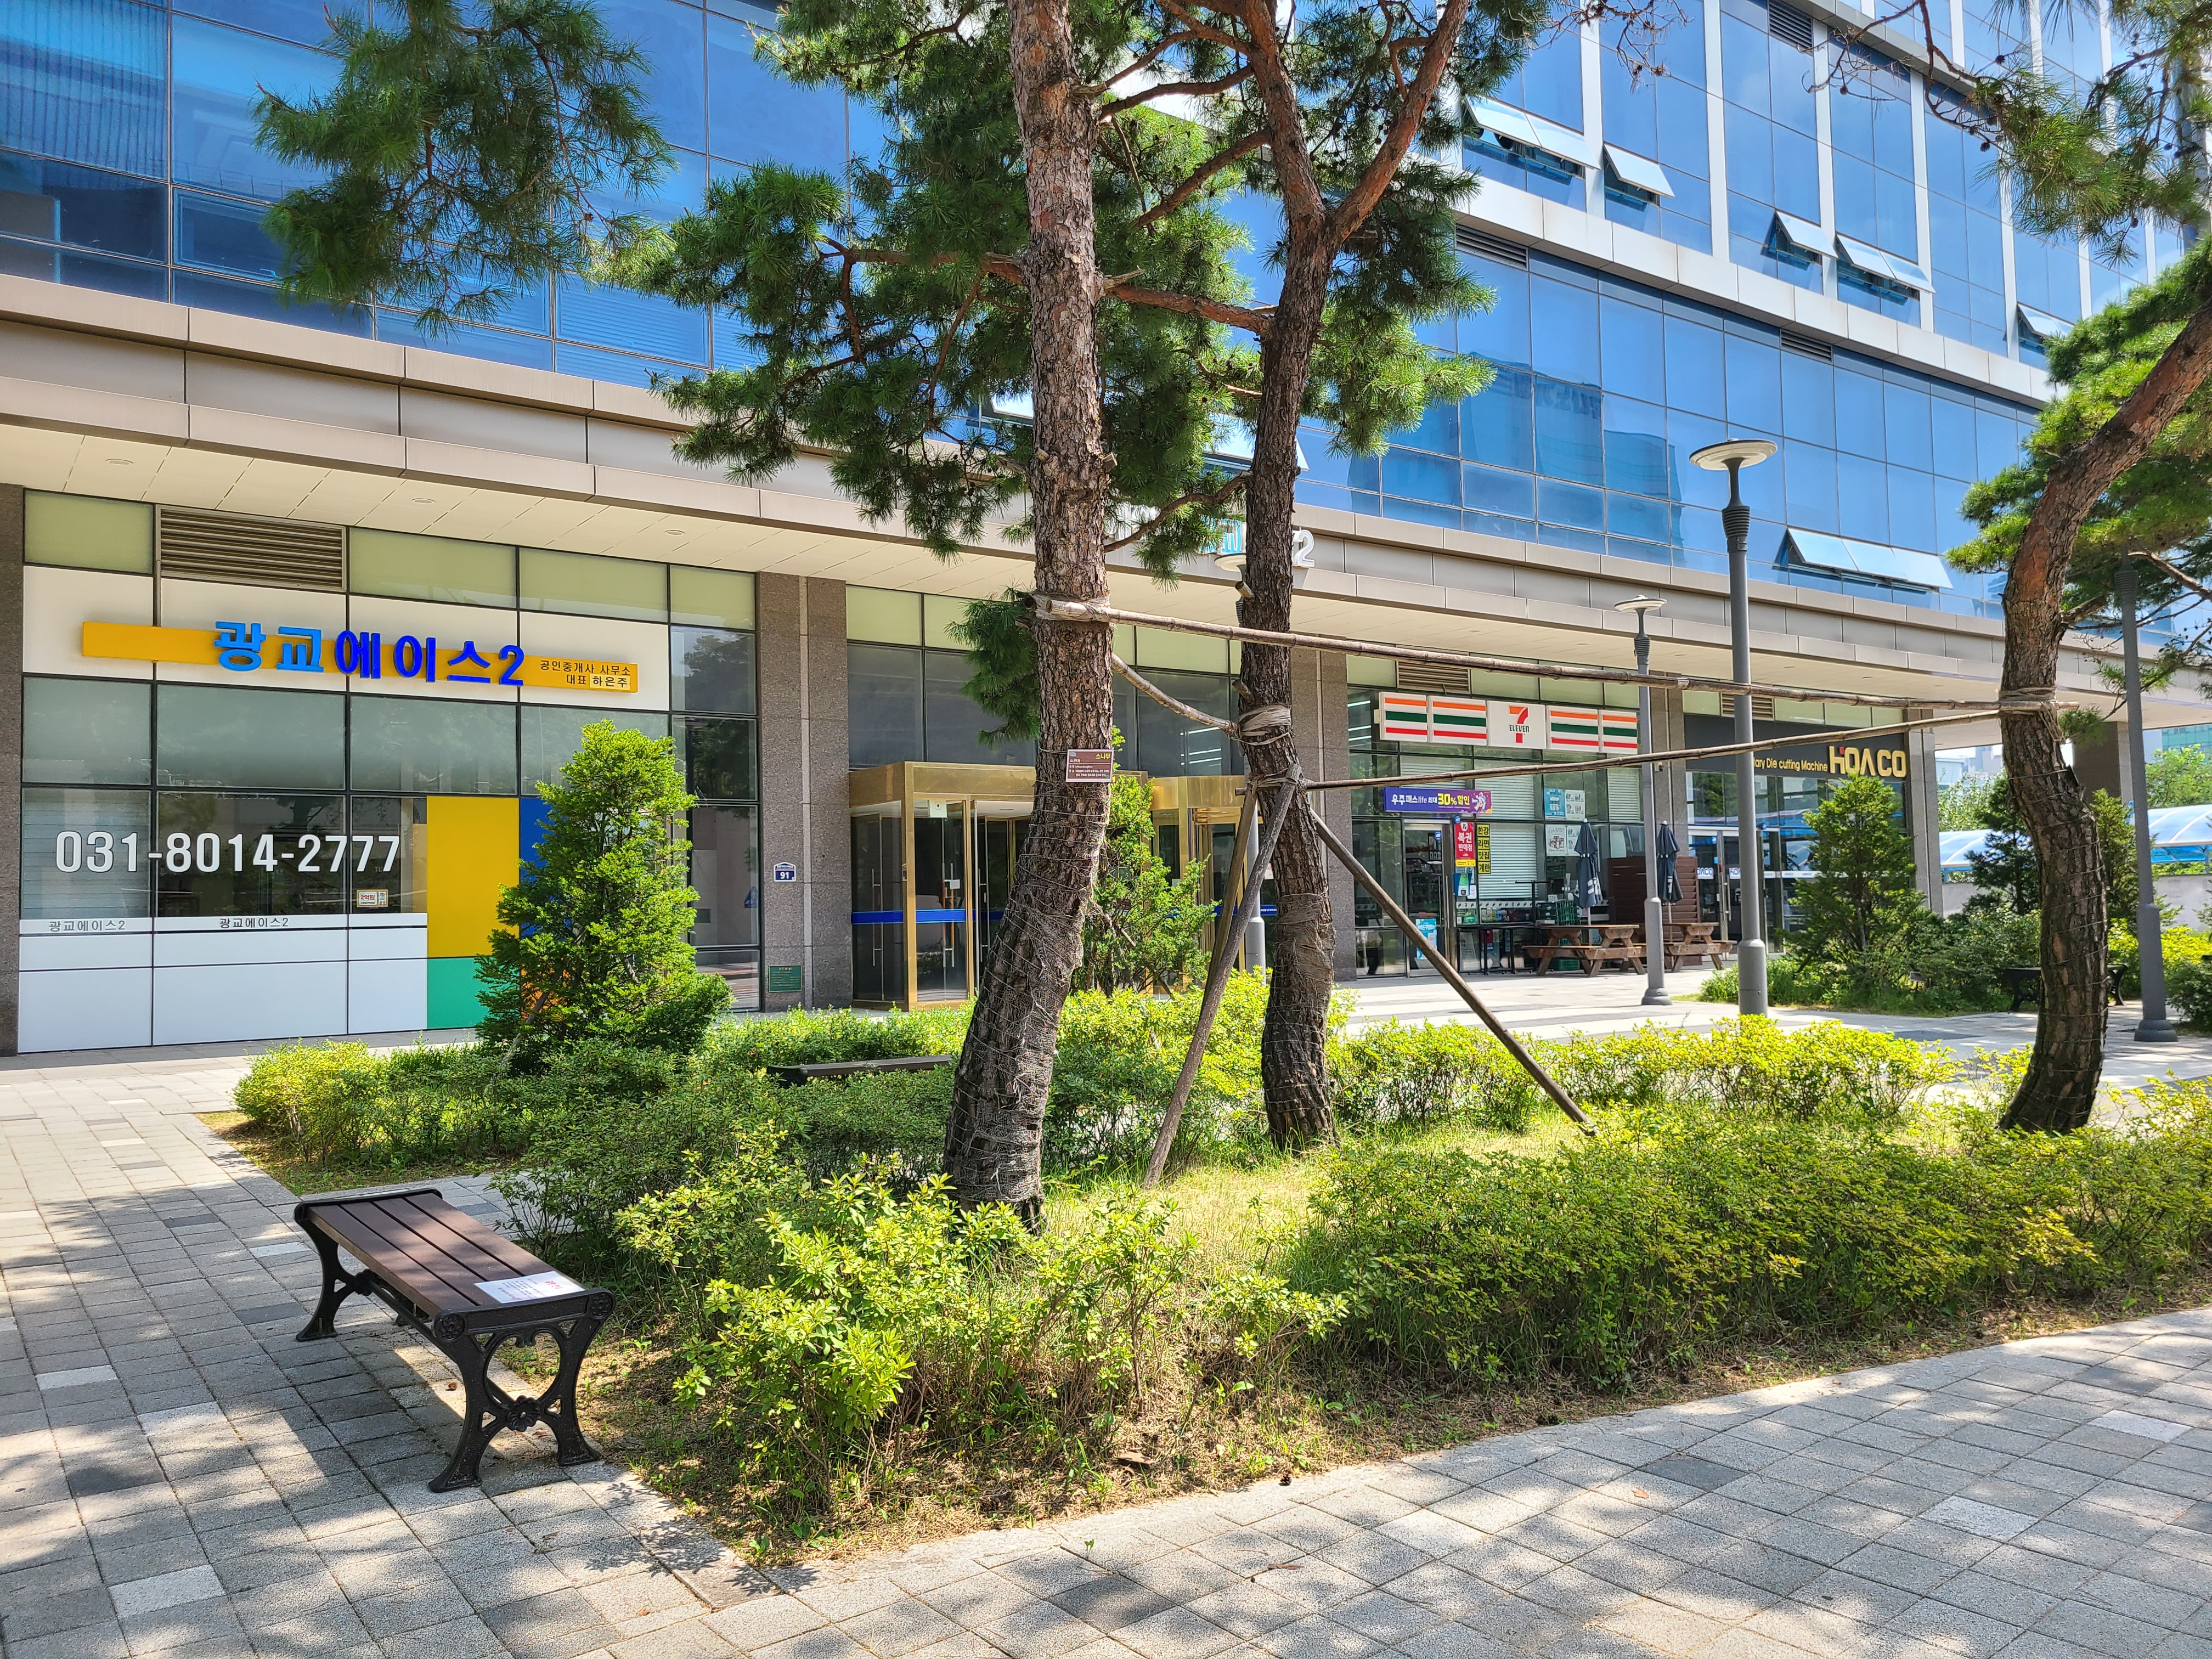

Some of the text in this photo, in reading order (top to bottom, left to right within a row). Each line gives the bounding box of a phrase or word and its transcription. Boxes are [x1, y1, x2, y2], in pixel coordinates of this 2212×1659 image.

[214, 620, 525, 687] 광교에이스2
[540, 660, 630, 676] 공인중개사 사무소
[566, 674, 628, 688] 대표 하은주
[1509, 706, 1528, 743] 7
[1766, 758, 1778, 769] Die
[1779, 759, 1800, 772] cutting
[1801, 760, 1828, 772] Machine
[1437, 793, 1457, 805] 30%
[1457, 795, 1470, 805] 할인
[1478, 826, 1489, 835] 한강
[1458, 832, 1472, 844] 복권
[1478, 839, 1489, 848] 라면
[55, 831, 400, 873] 031-8014-2777
[1479, 851, 1490, 860] 맛집
[1479, 864, 1491, 872] 계란
[780, 871, 789, 879] 91
[49, 919, 126, 932] 광교에이스2
[219, 917, 289, 928] 광교에이스2
